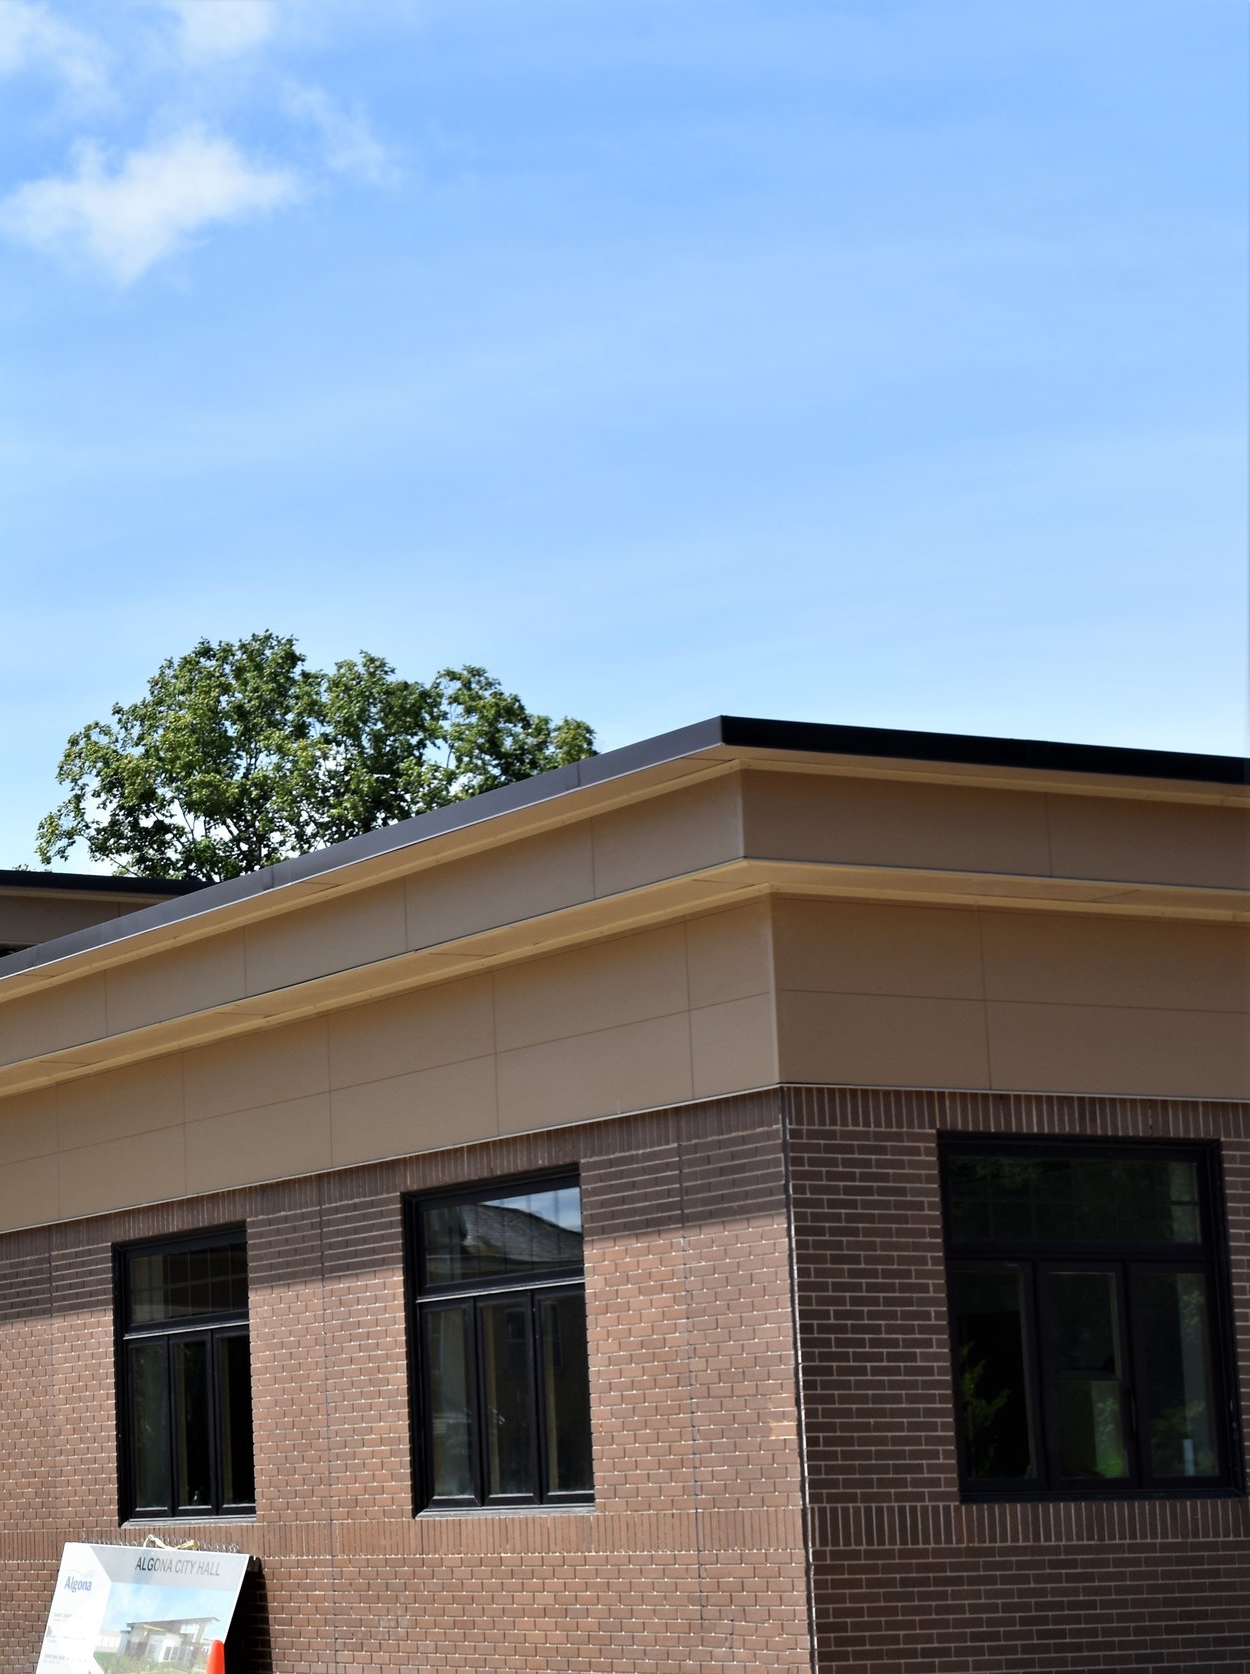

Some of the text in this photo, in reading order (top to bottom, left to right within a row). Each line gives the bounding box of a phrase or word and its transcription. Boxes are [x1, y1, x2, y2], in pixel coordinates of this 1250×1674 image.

[135, 1556, 221, 1576] ALGONA CITY HALL
[64, 1576, 92, 1593] Algona
